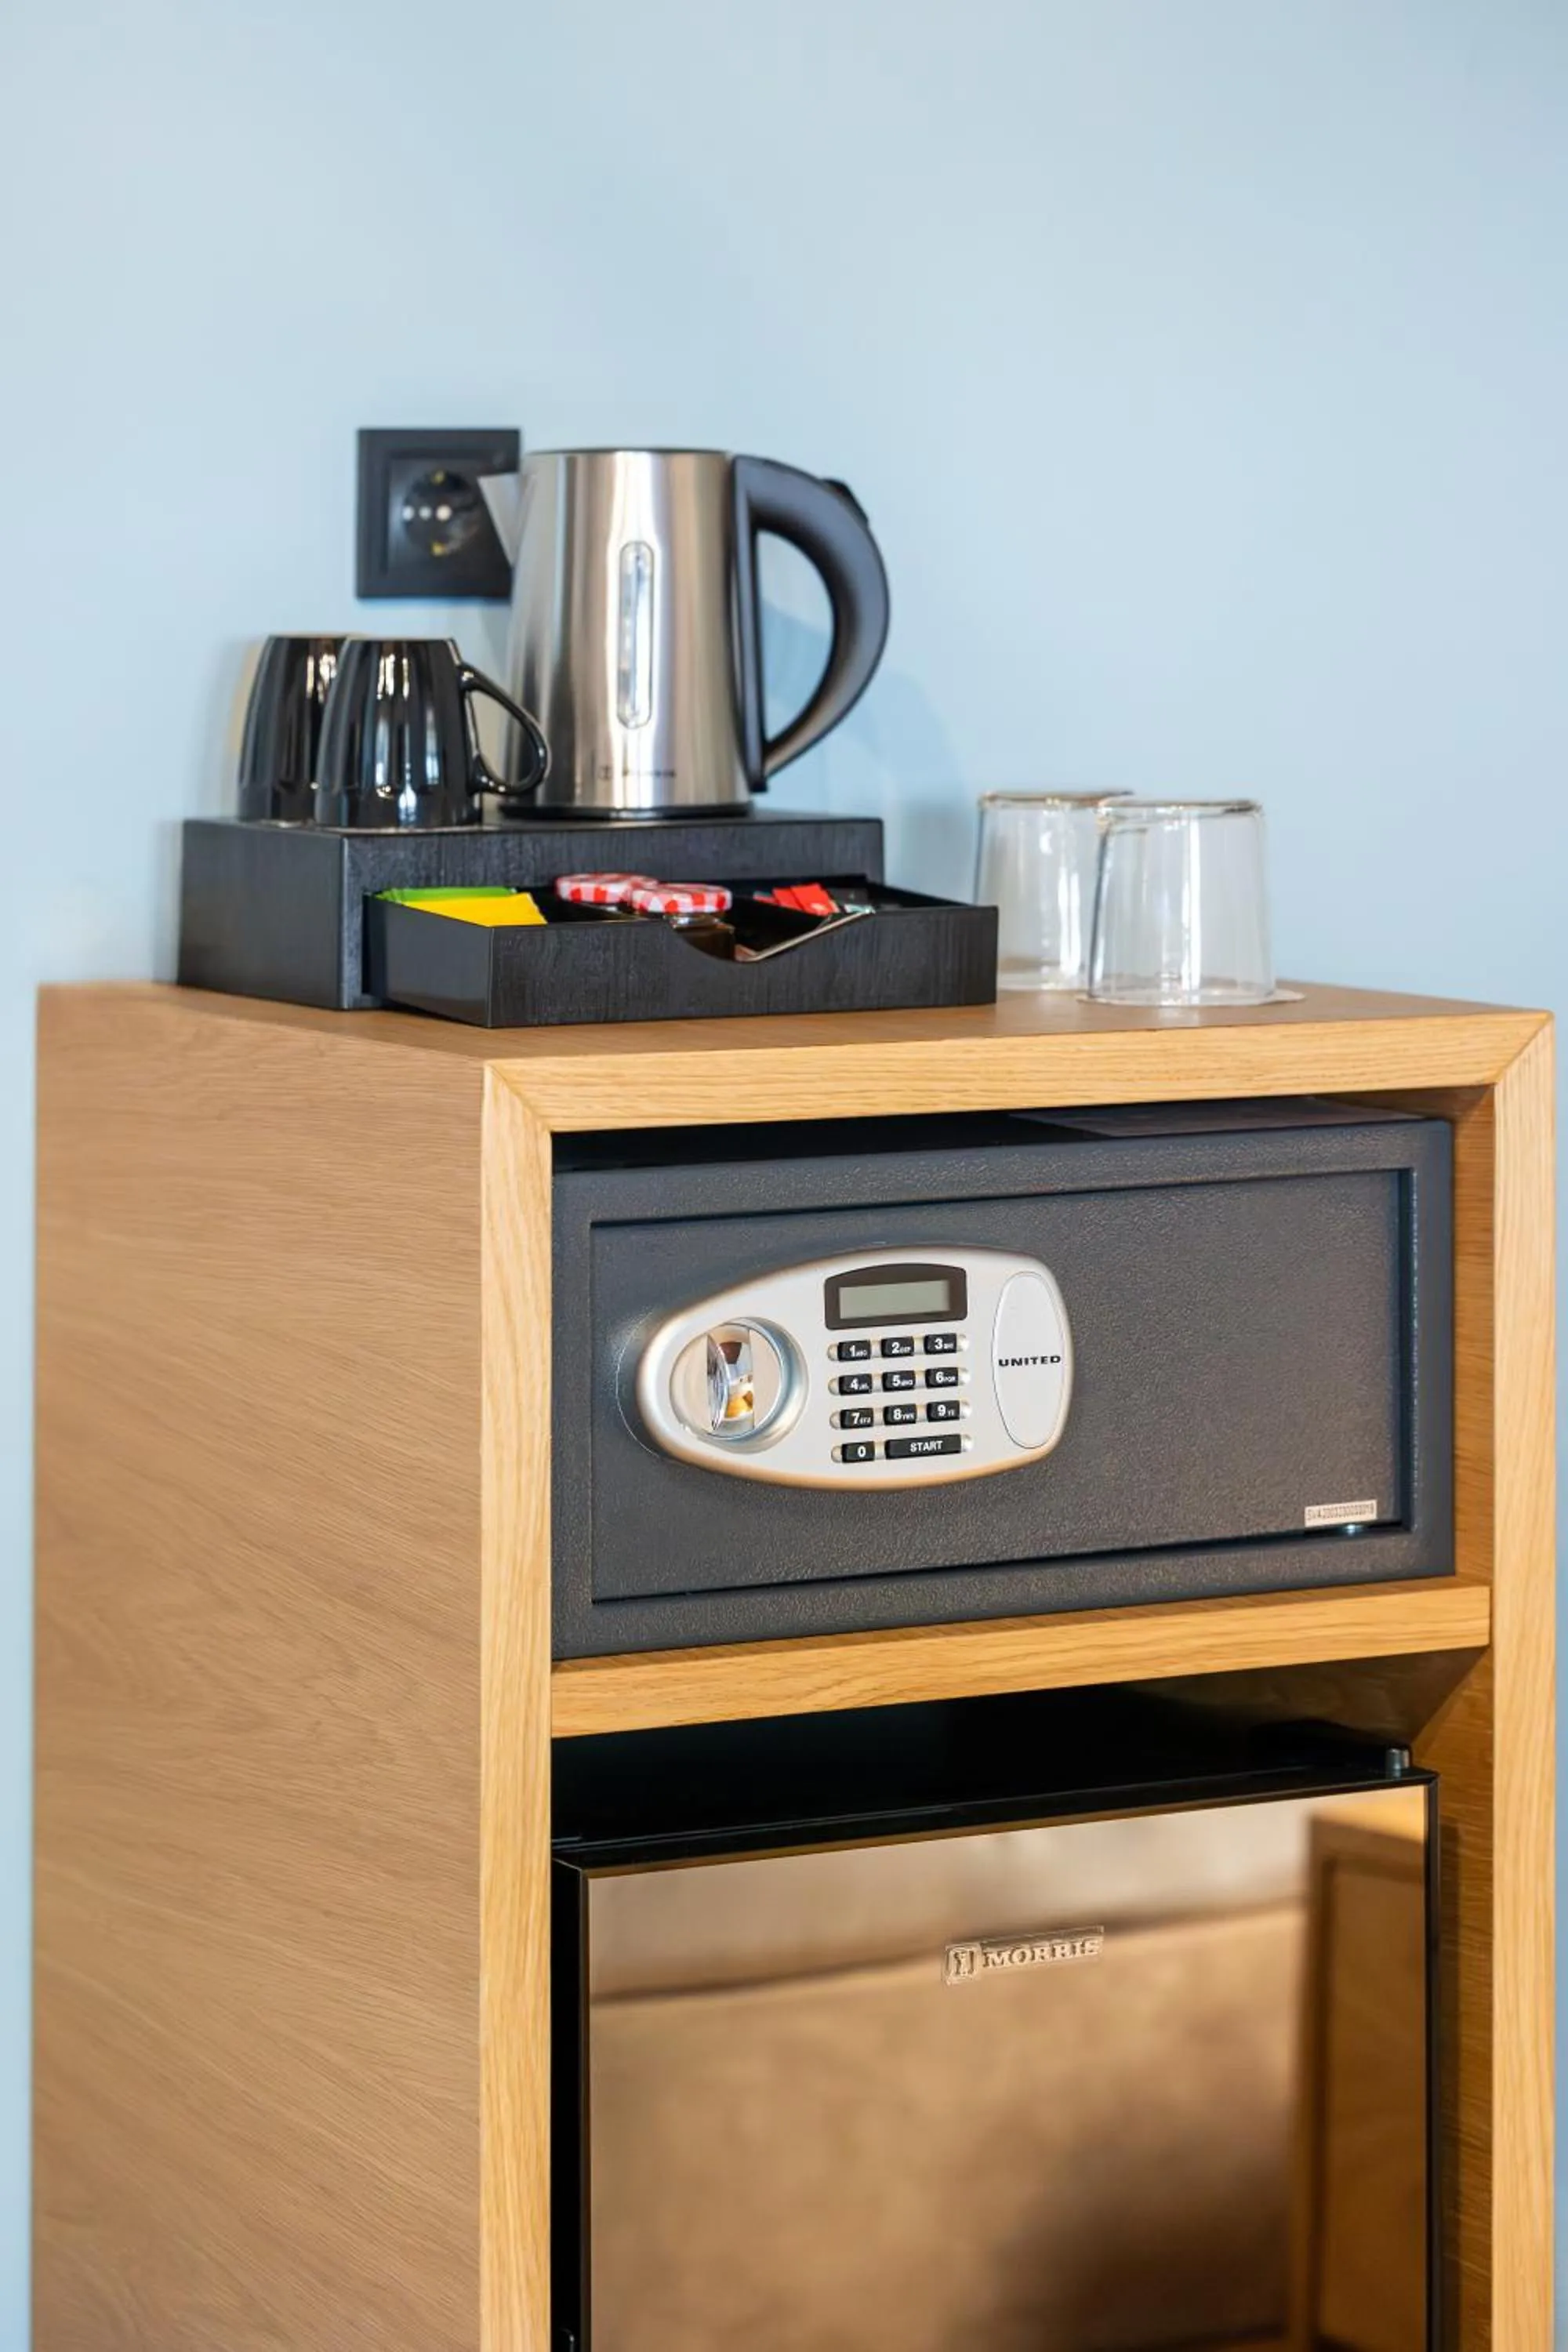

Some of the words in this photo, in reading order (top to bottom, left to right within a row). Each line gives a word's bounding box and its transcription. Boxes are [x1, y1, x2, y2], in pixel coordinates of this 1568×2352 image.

[891, 1341, 899, 1354] 2
[934, 1338, 943, 1349] 3
[849, 1345, 856, 1357] 1
[998, 1356, 1061, 1367] UNITED
[850, 1377, 858, 1390] 4
[892, 1374, 900, 1387] 5
[935, 1371, 944, 1383] 6
[893, 1408, 902, 1421] 8
[937, 1404, 946, 1417] 9
[851, 1412, 860, 1425] 7
[857, 1445, 866, 1457] 0
[910, 1440, 943, 1452] START
[982, 1938, 1101, 1969] MORRIS
